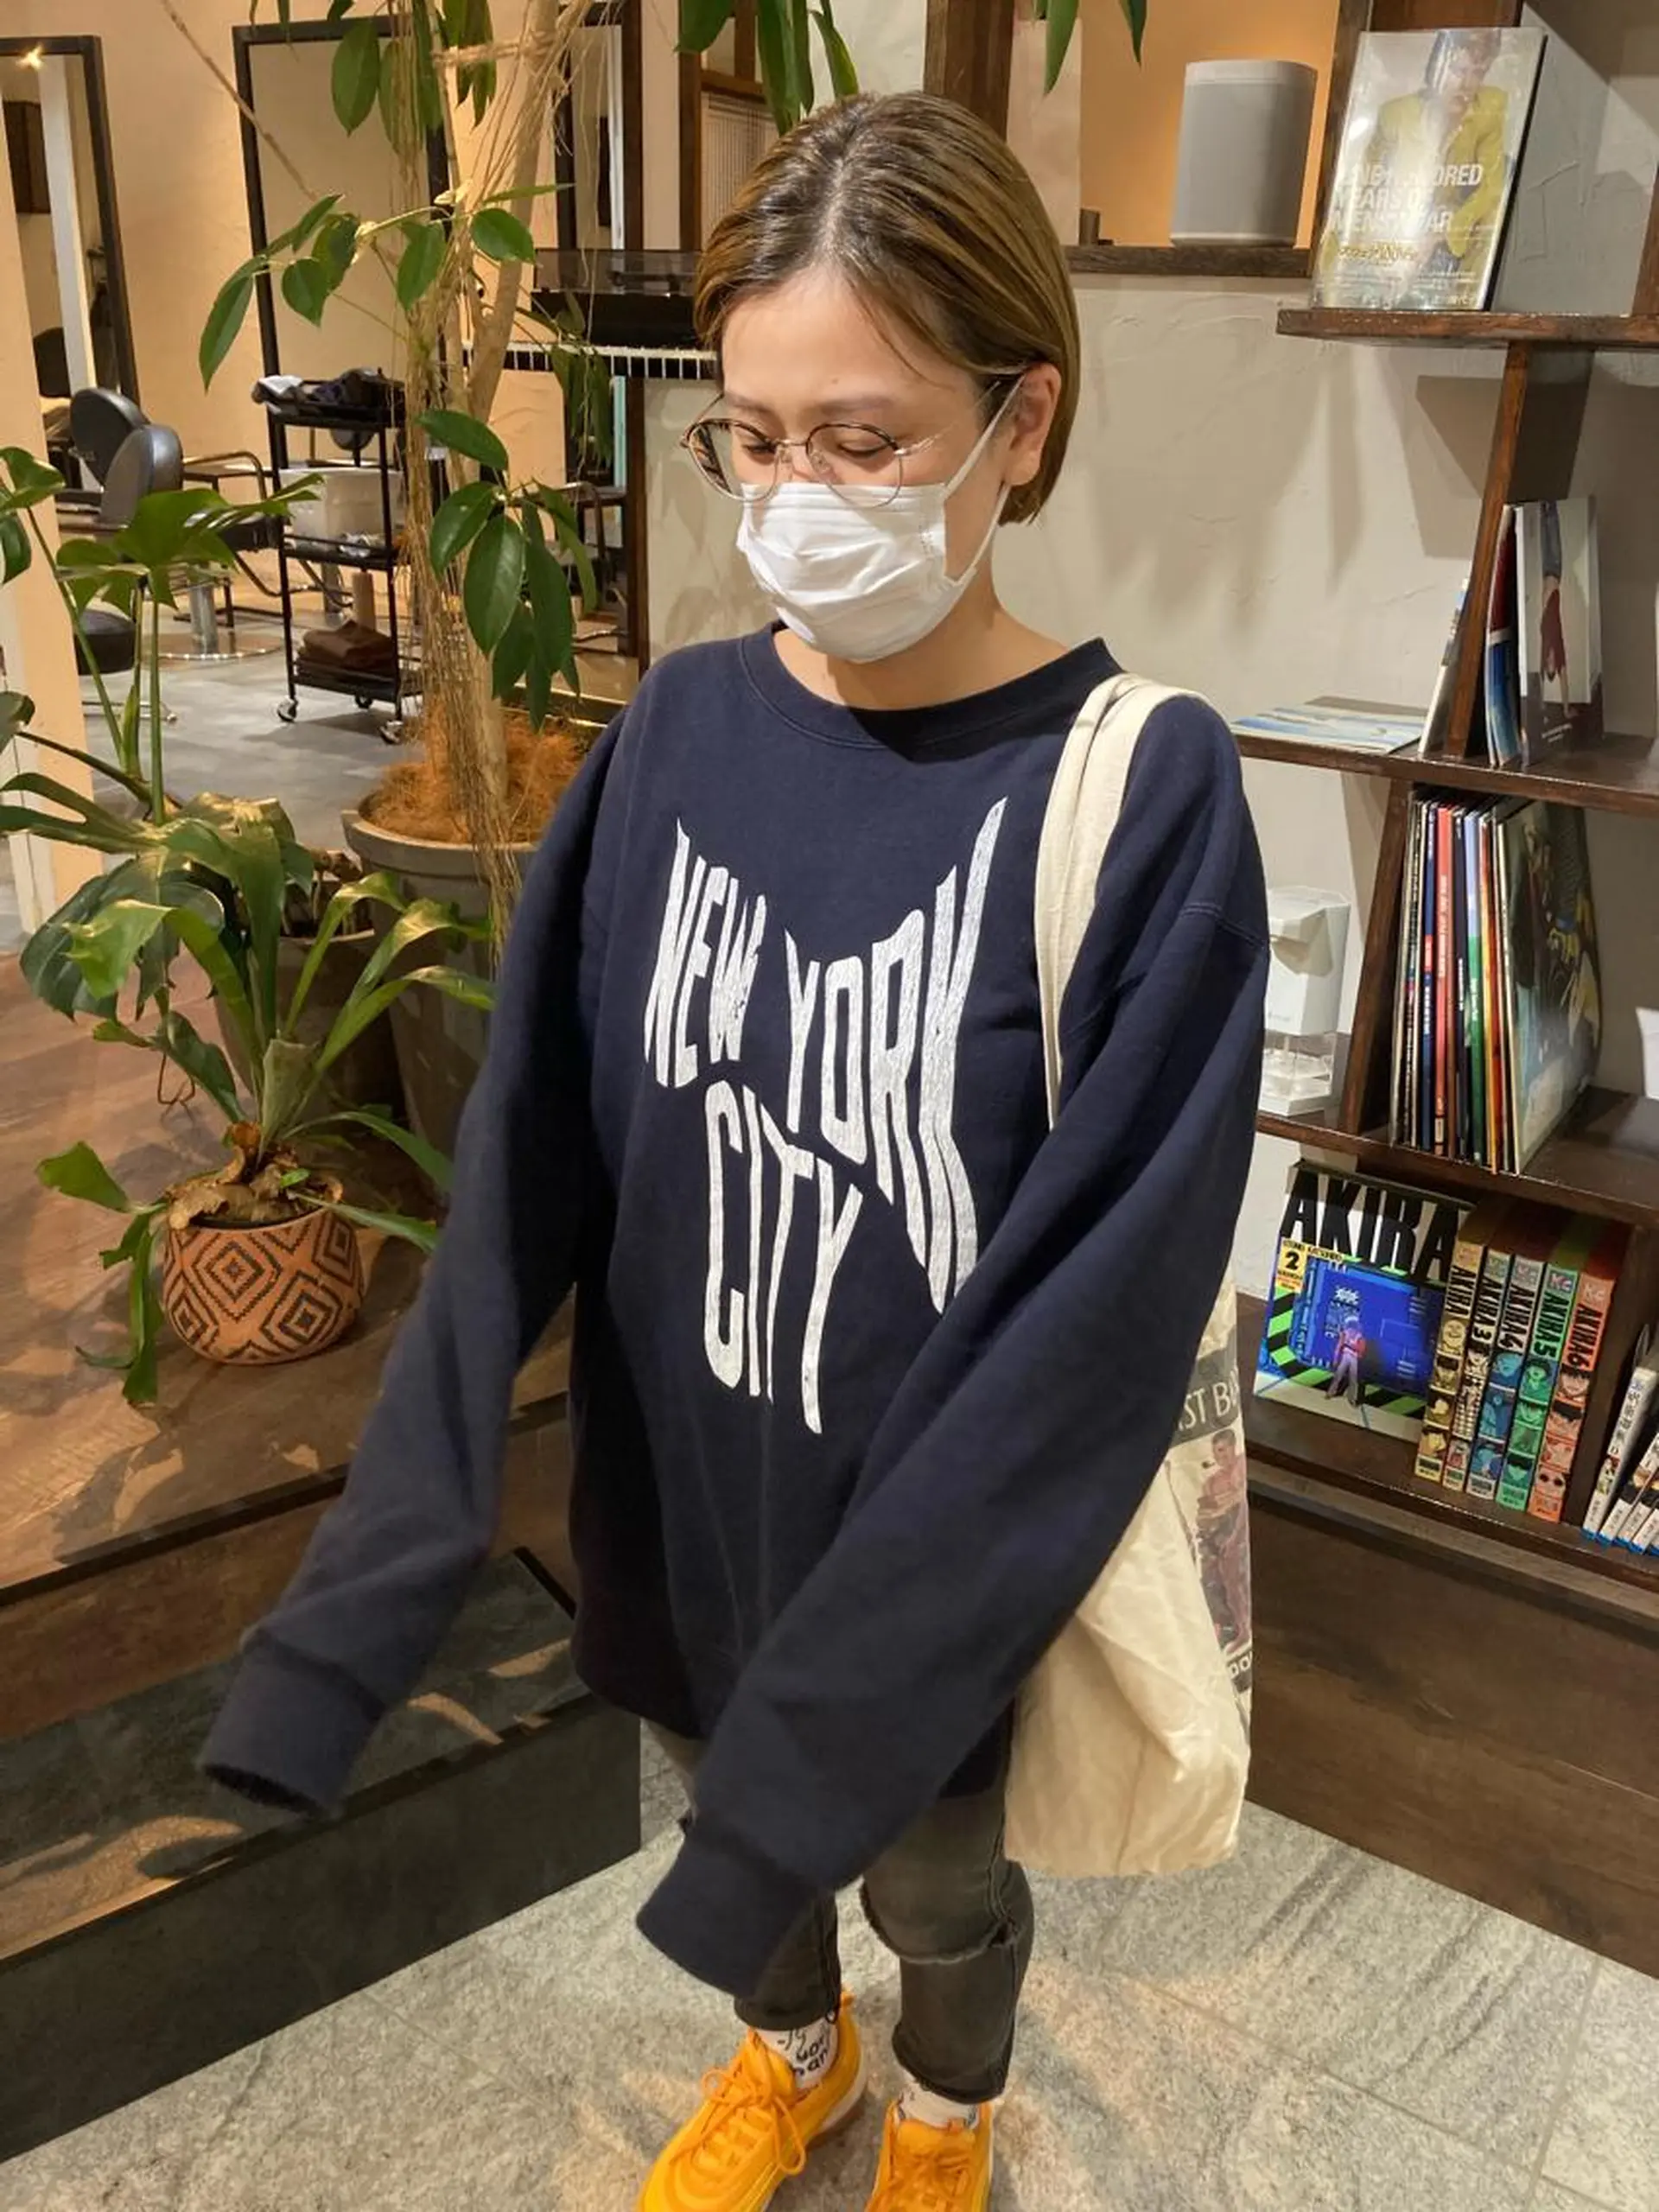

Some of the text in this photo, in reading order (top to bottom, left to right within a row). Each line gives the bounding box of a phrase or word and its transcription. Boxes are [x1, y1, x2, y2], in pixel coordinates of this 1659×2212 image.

[645, 817, 767, 1089] NEW
[785, 797, 1007, 1314] YORK
[703, 1079, 863, 1434] CITY
[1280, 1167, 1460, 1283] AKIRA
[1285, 1251, 1300, 1271] 2
[1445, 1265, 1477, 1318] AKIRA
[1179, 1387, 1207, 1432] ST
